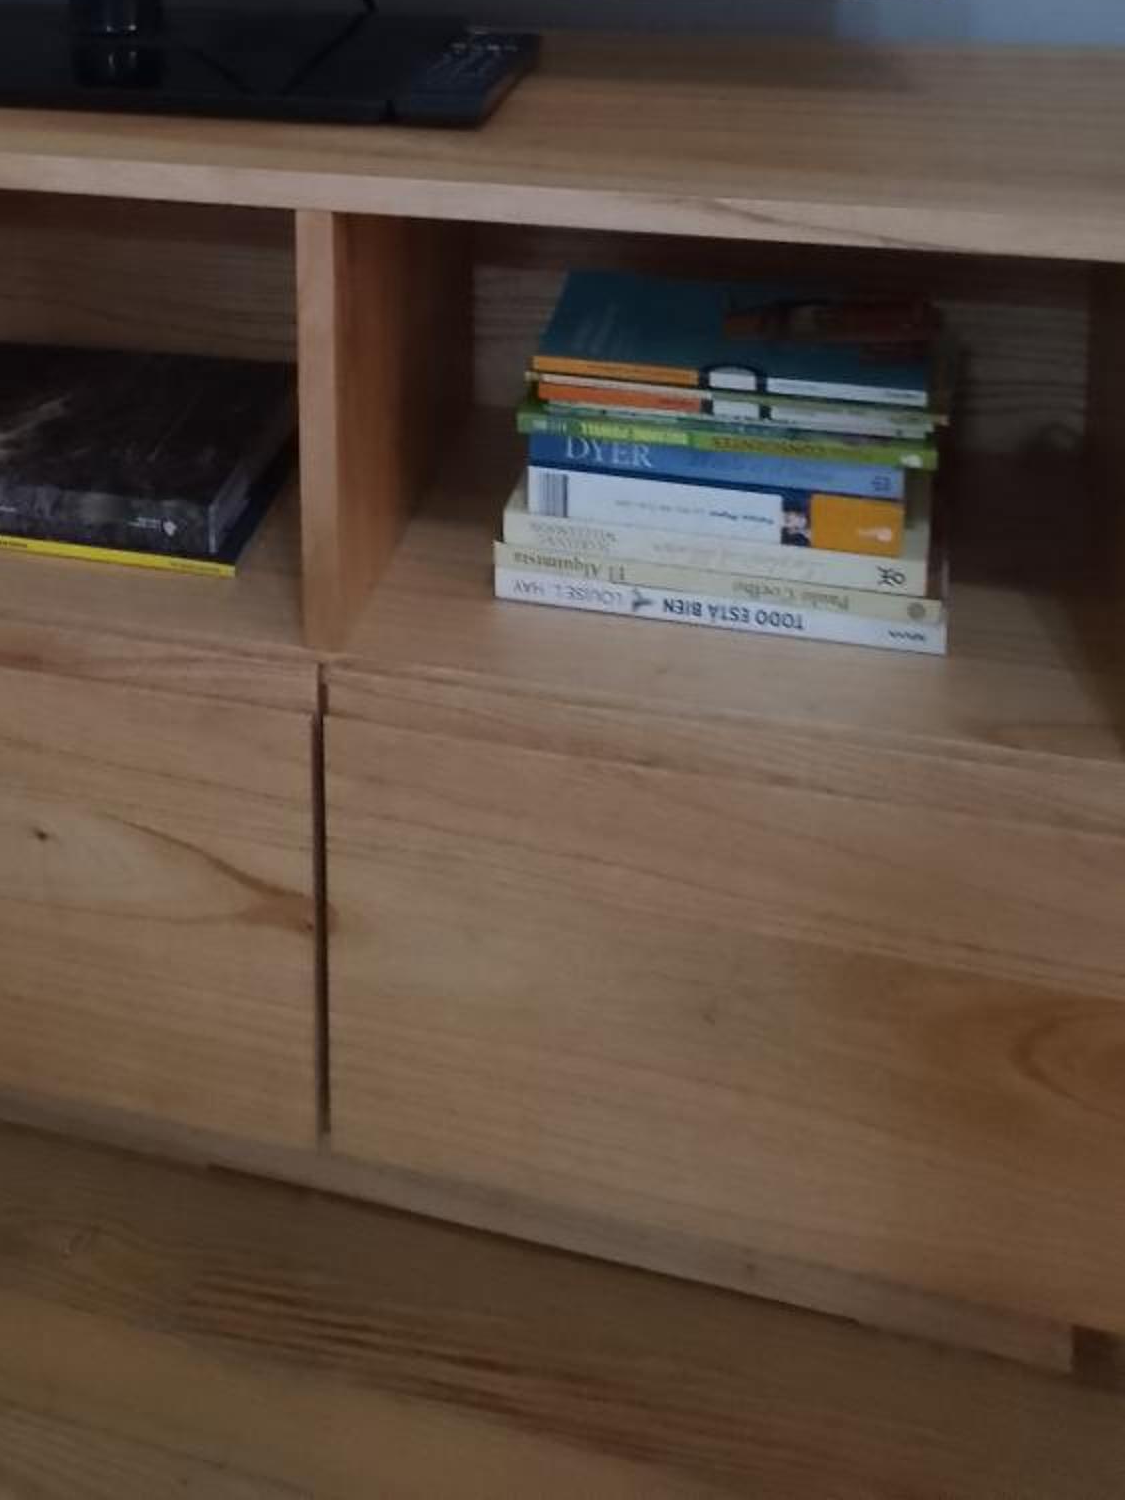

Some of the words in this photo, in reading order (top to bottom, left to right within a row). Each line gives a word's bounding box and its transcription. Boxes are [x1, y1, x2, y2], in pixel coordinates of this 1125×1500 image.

[565, 435, 652, 468] DYER
[513, 579, 546, 597] HAY
[565, 585, 623, 605] LOUISE
[662, 597, 703, 617] BIEN
[754, 609, 805, 631] TODO
